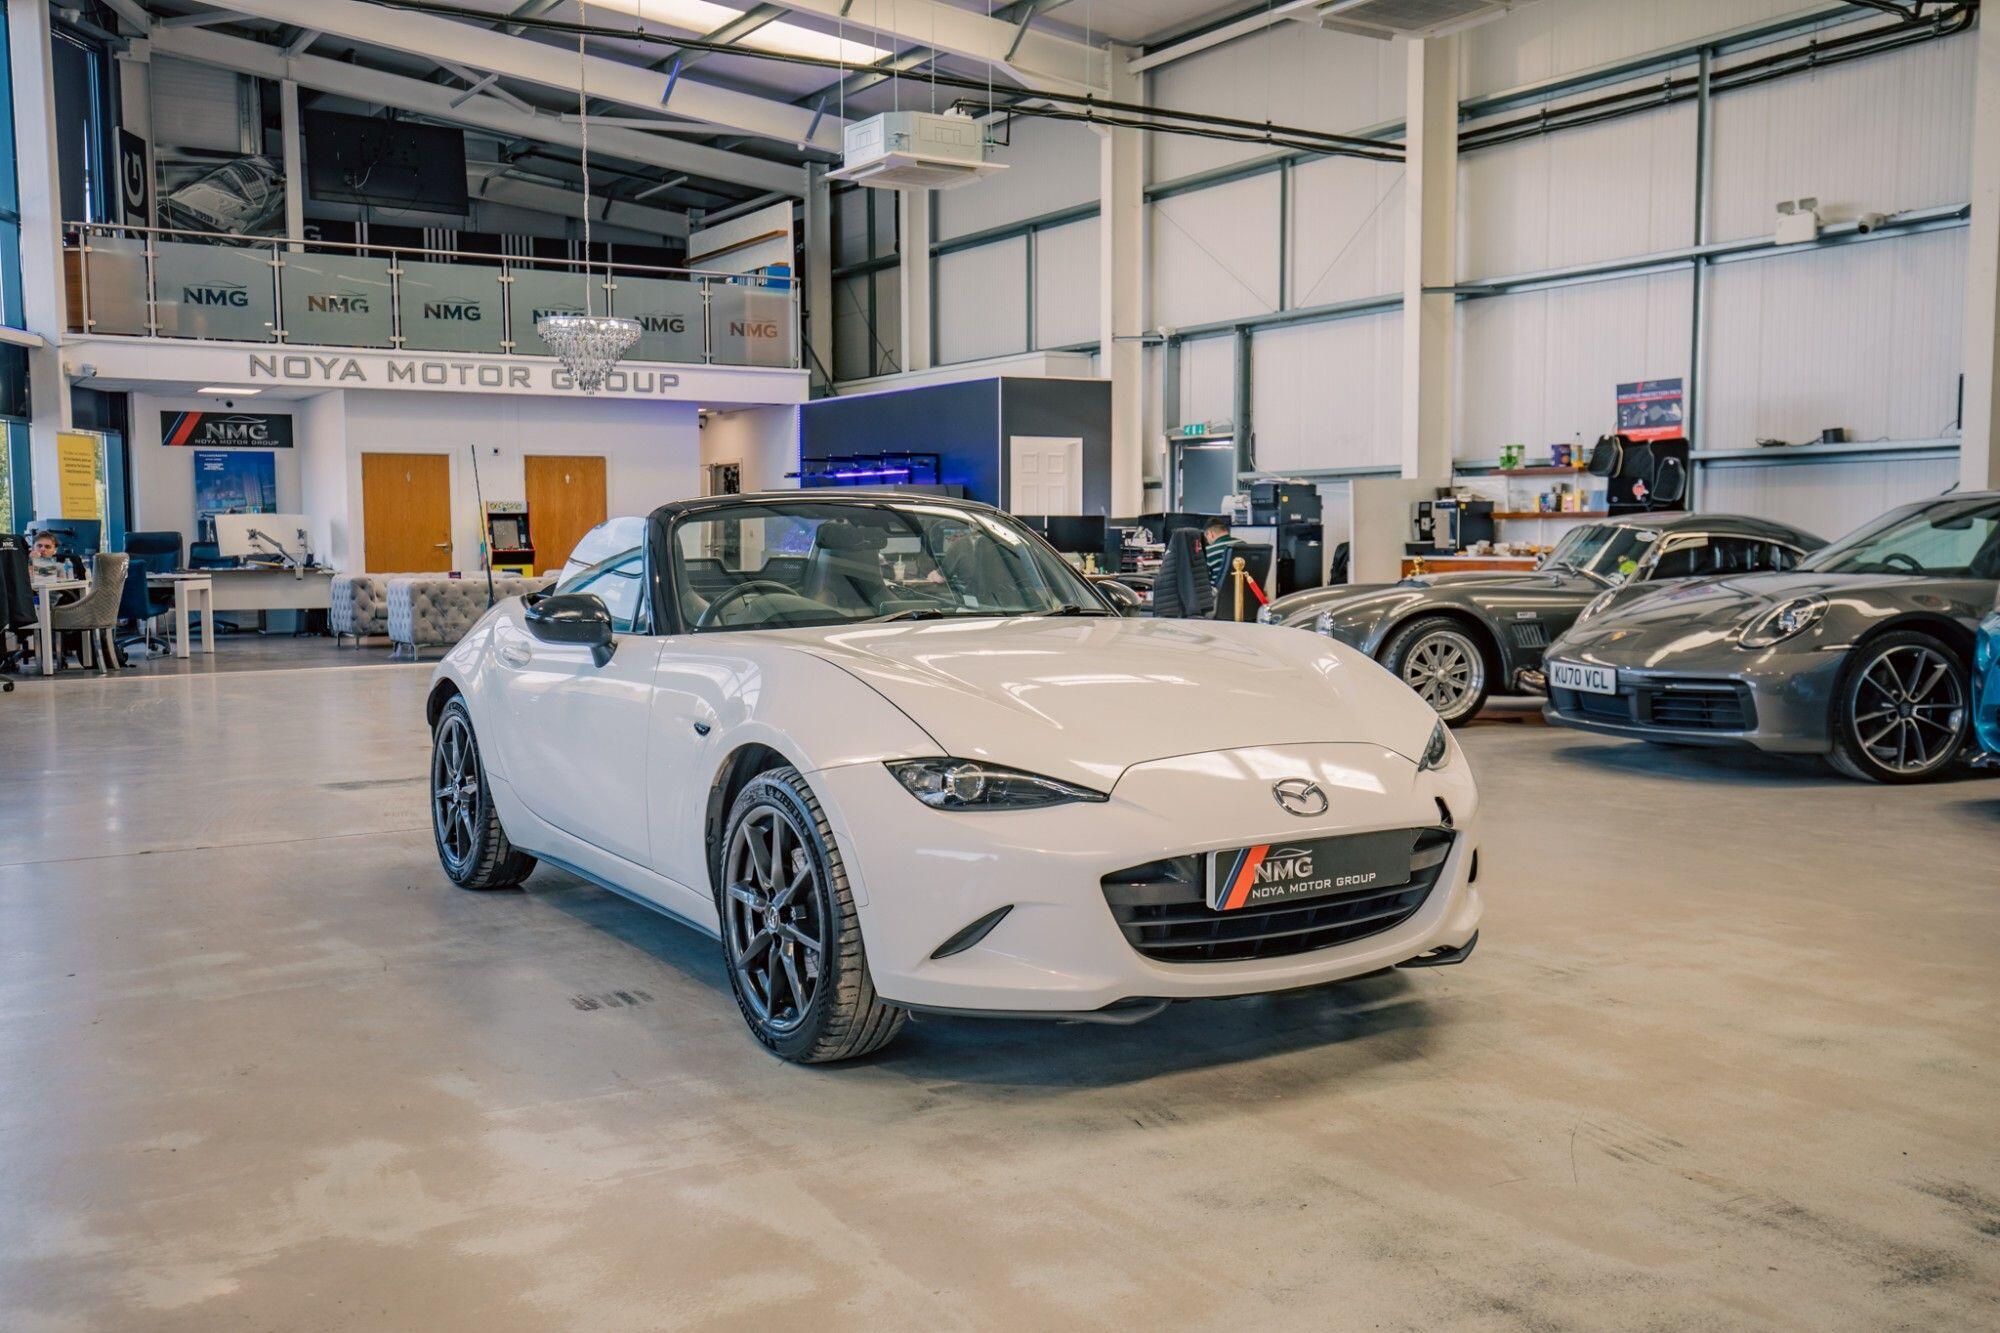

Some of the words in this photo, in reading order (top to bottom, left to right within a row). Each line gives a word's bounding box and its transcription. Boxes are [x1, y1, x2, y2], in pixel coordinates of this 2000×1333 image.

[183, 287, 249, 307] NMG
[308, 295, 369, 314] NMG
[424, 303, 481, 321] NMG
[635, 316, 685, 333] NMG
[730, 321, 778, 338] NMG
[250, 354, 367, 381] NOYA
[387, 360, 531, 388] MOTOR
[551, 368, 680, 394] GOUP
[205, 423, 268, 440] NMG
[1555, 665, 1582, 686] KU70
[1584, 669, 1609, 690] VCL
[1253, 856, 1314, 885] NMG
[1252, 886, 1285, 899] NOYA
[1289, 878, 1332, 893] MOTOR
[1336, 872, 1378, 887] GROUP
